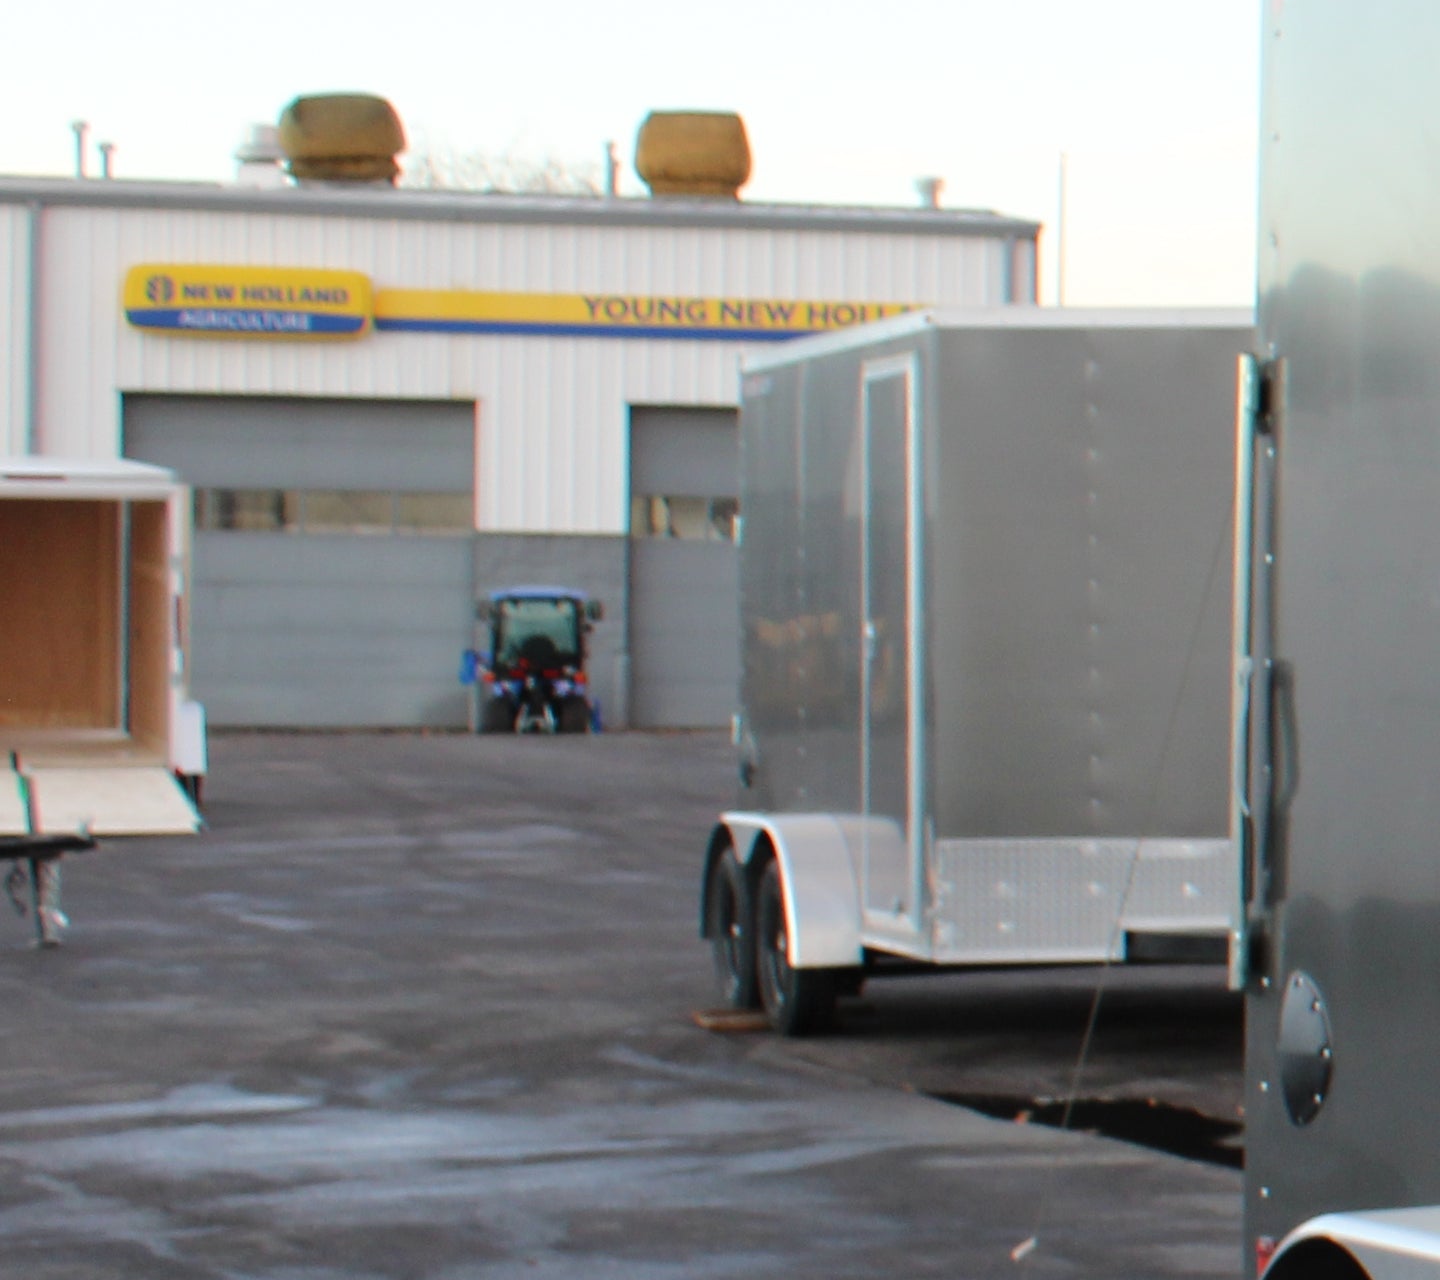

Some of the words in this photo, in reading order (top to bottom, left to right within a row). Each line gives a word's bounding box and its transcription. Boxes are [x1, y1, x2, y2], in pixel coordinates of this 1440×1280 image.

[182, 283, 235, 302] NEW
[241, 285, 350, 305] HOLLAND
[178, 310, 311, 331] AGRICULTURE
[584, 296, 707, 322] YOUNG
[719, 300, 797, 323] NEW
